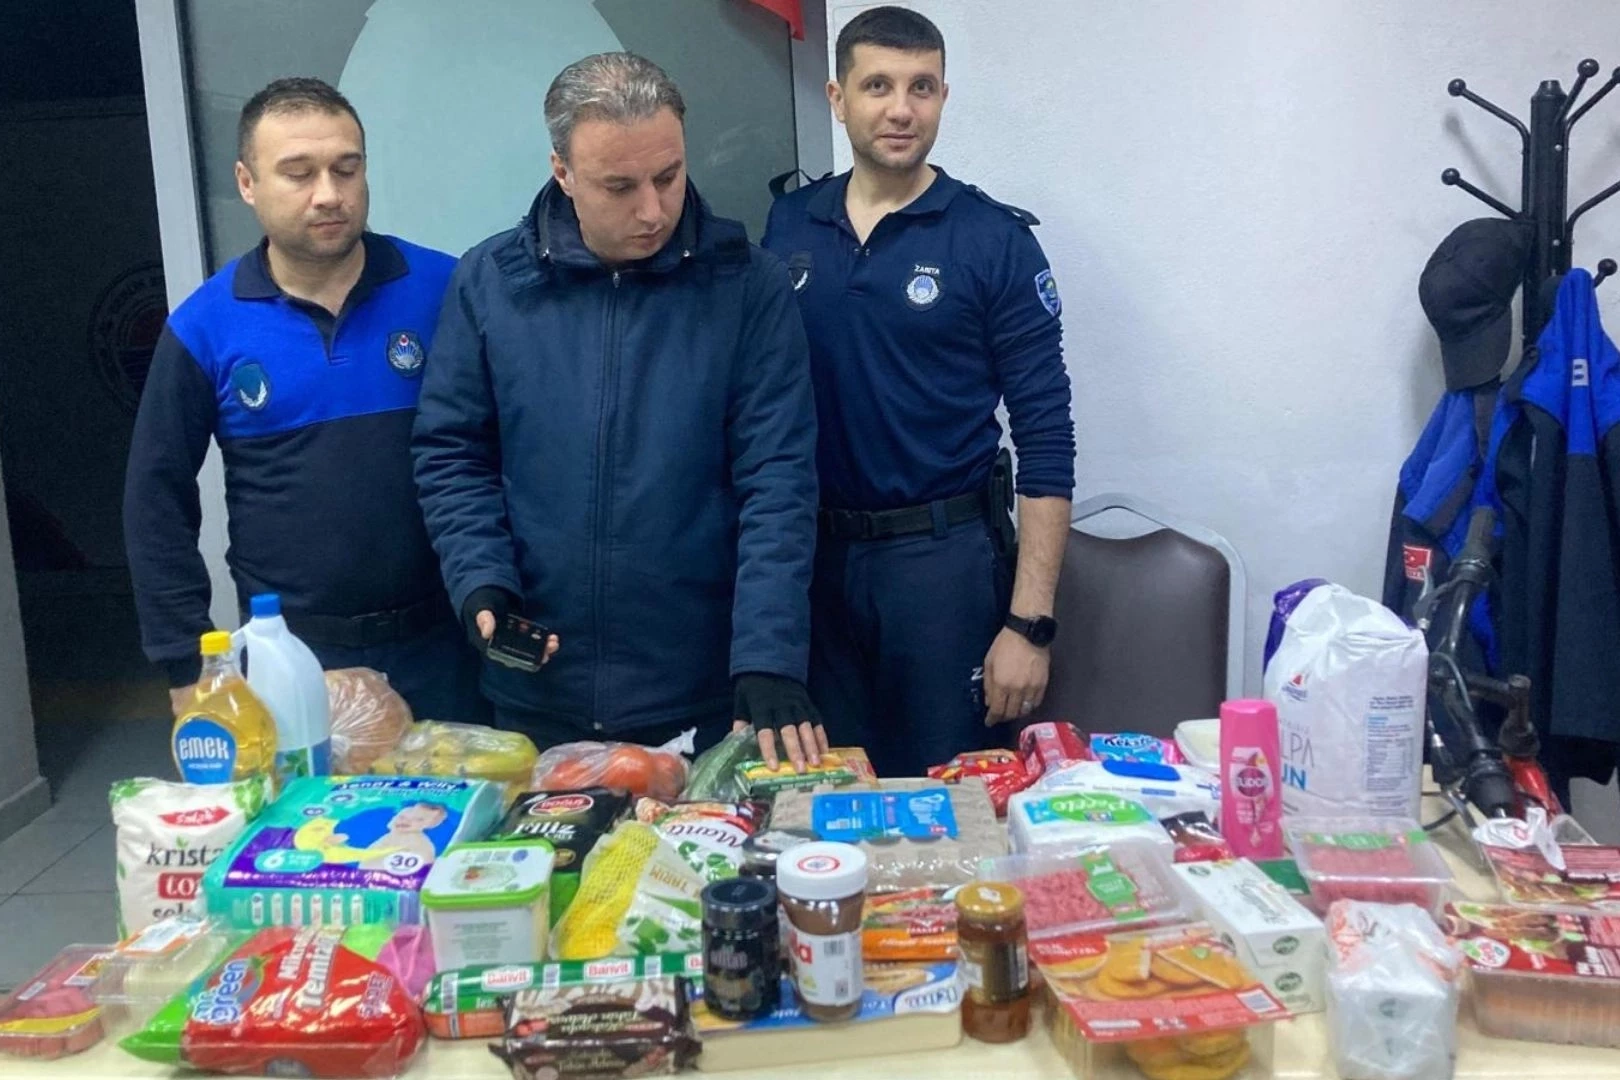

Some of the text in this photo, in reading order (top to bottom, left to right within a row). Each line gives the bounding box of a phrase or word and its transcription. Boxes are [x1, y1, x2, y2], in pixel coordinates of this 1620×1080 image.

[179, 736, 230, 761] emek
[146, 841, 231, 867] krista
[263, 850, 286, 868] 6
[390, 854, 418, 868] 30
[166, 874, 201, 897] to
[487, 970, 528, 986] Banvit
[588, 961, 629, 977] Banvit
[211, 958, 248, 1025] green
